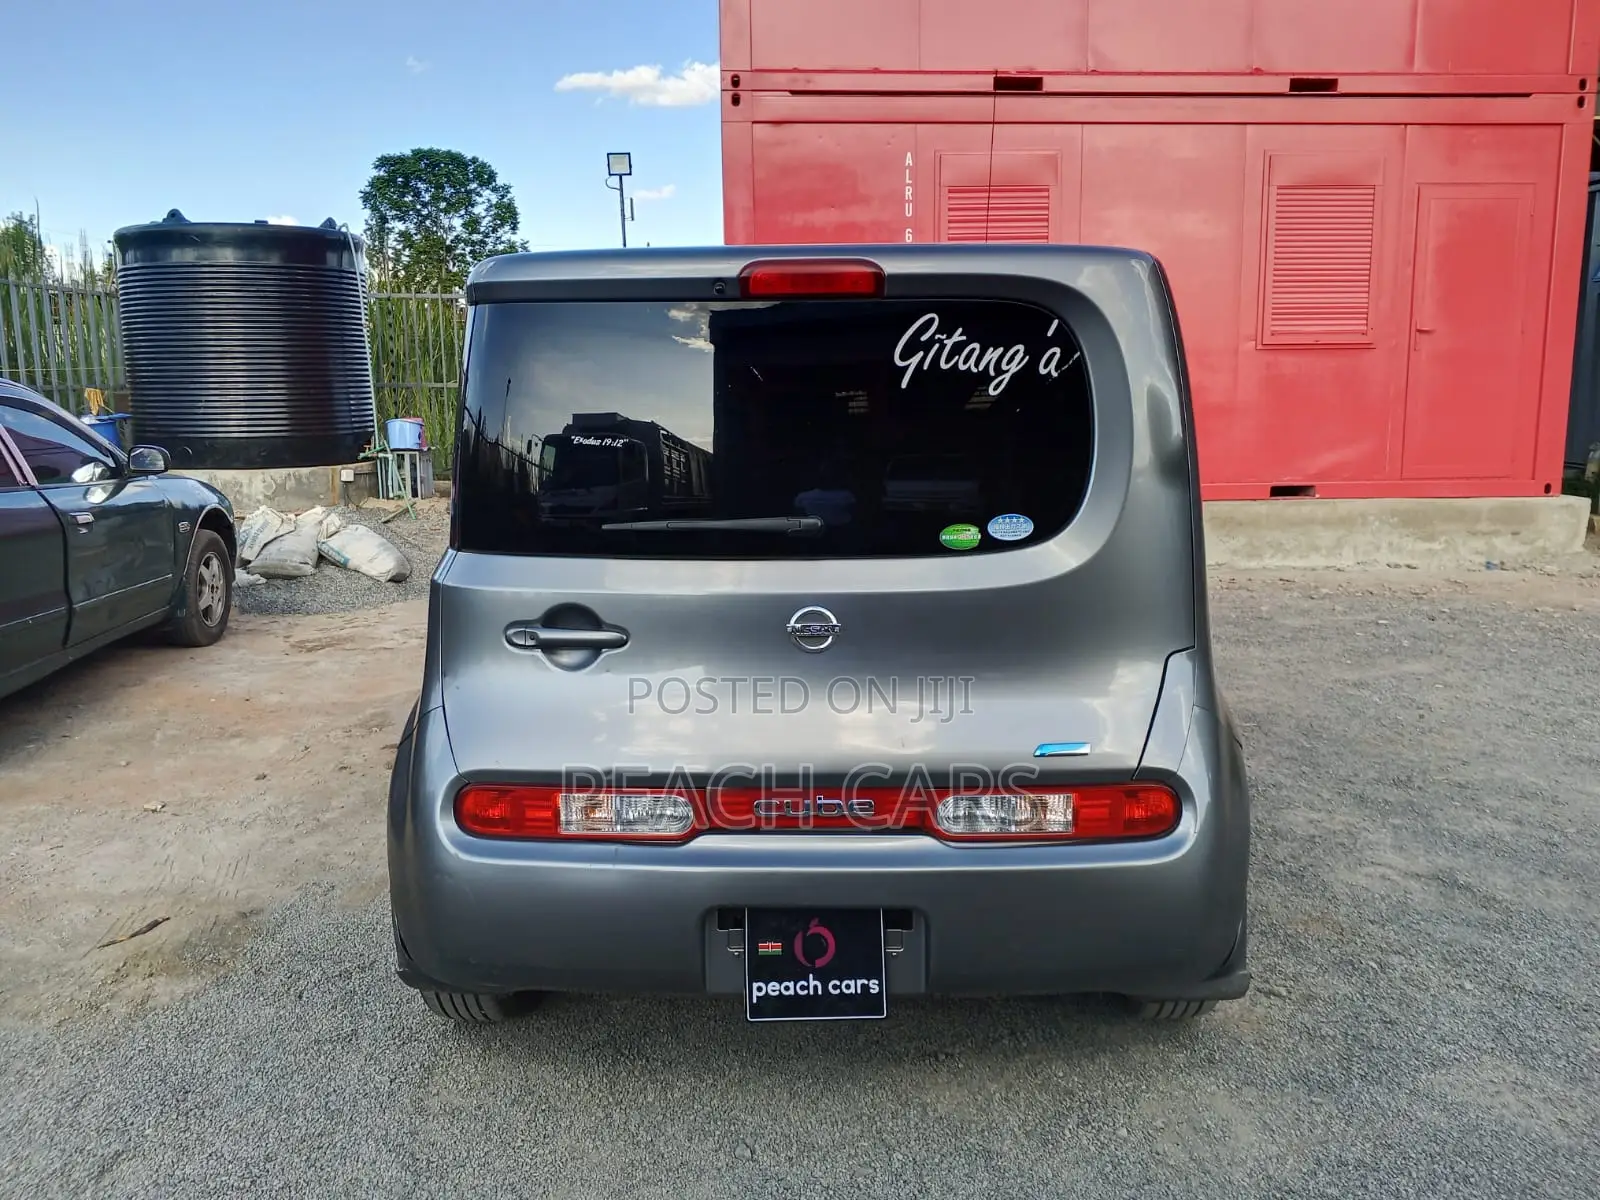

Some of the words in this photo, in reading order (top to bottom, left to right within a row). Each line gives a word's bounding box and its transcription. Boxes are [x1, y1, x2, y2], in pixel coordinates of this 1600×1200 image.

[905, 151, 913, 217] ALRU
[753, 795, 875, 817] cube
[752, 973, 822, 1004] peach
[828, 979, 879, 995] cars
